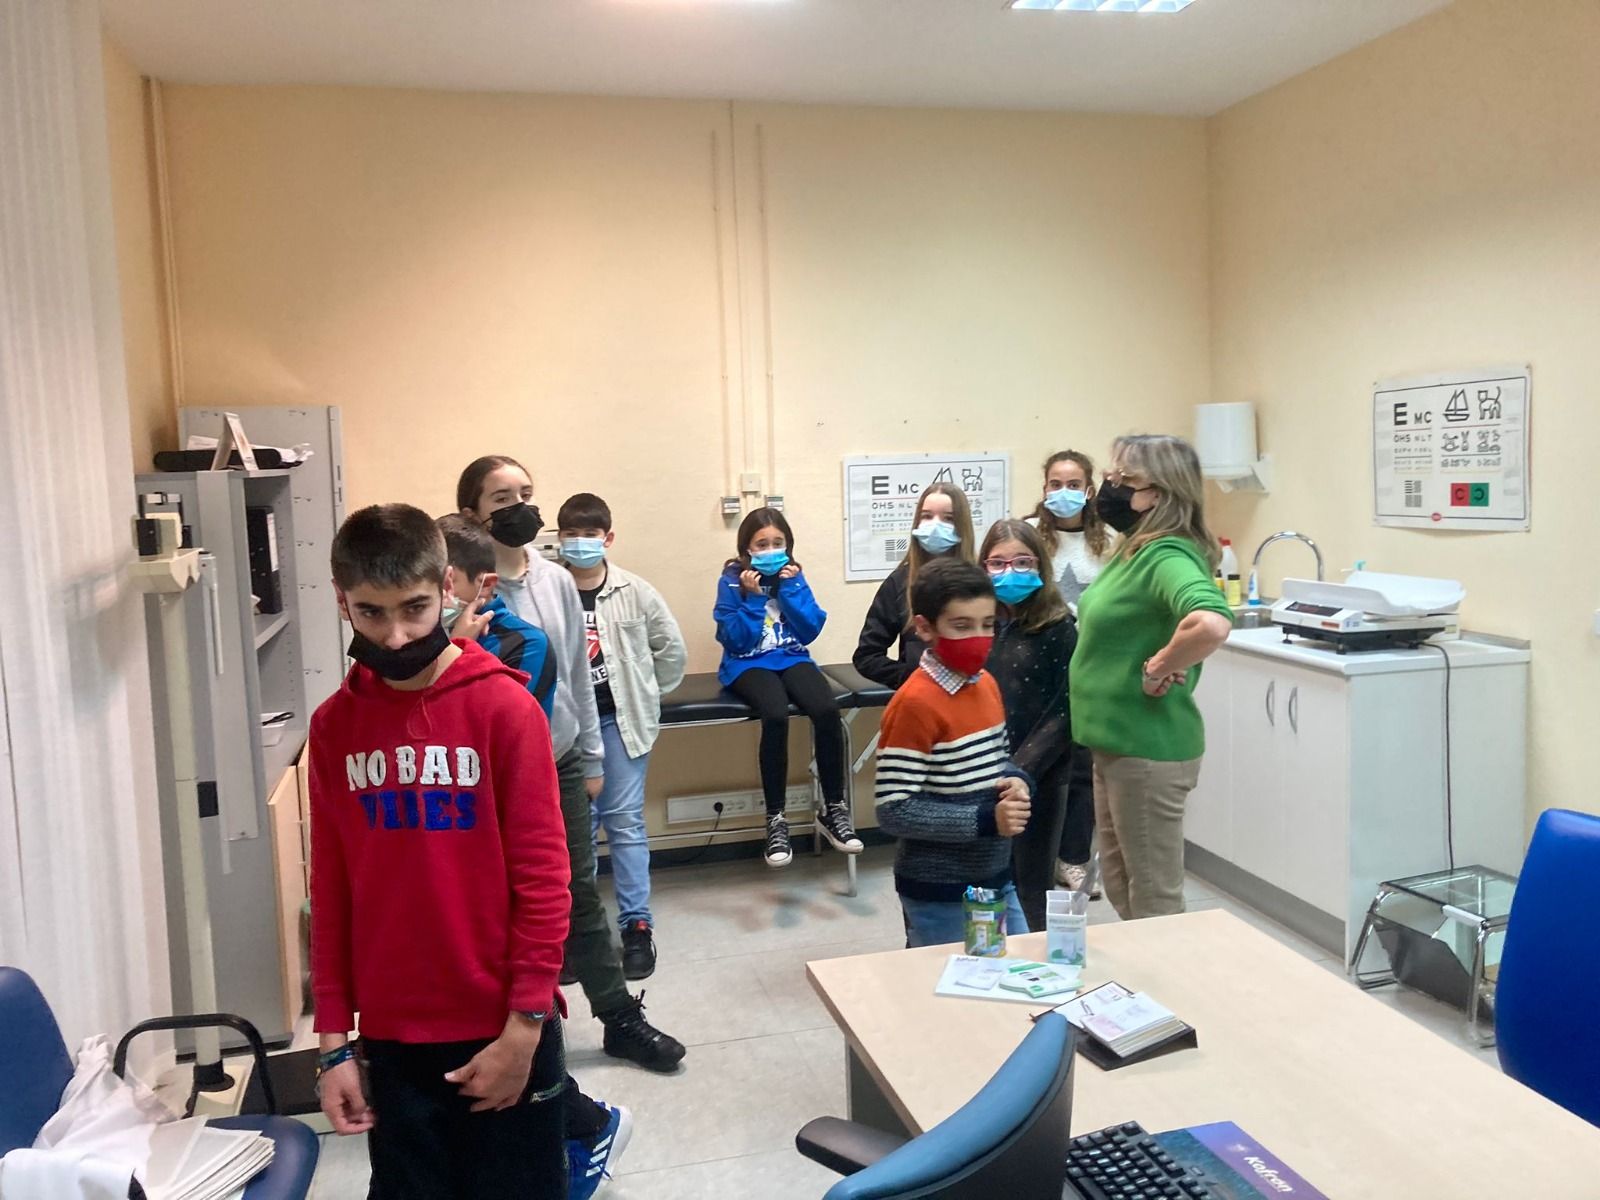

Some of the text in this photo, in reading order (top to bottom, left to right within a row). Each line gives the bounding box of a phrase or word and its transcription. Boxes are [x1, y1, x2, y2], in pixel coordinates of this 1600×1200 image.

[1393, 402, 1433, 426] E MC
[871, 475, 920, 495] E MC
[871, 502, 895, 510] OHS
[345, 745, 482, 791] NO BAD
